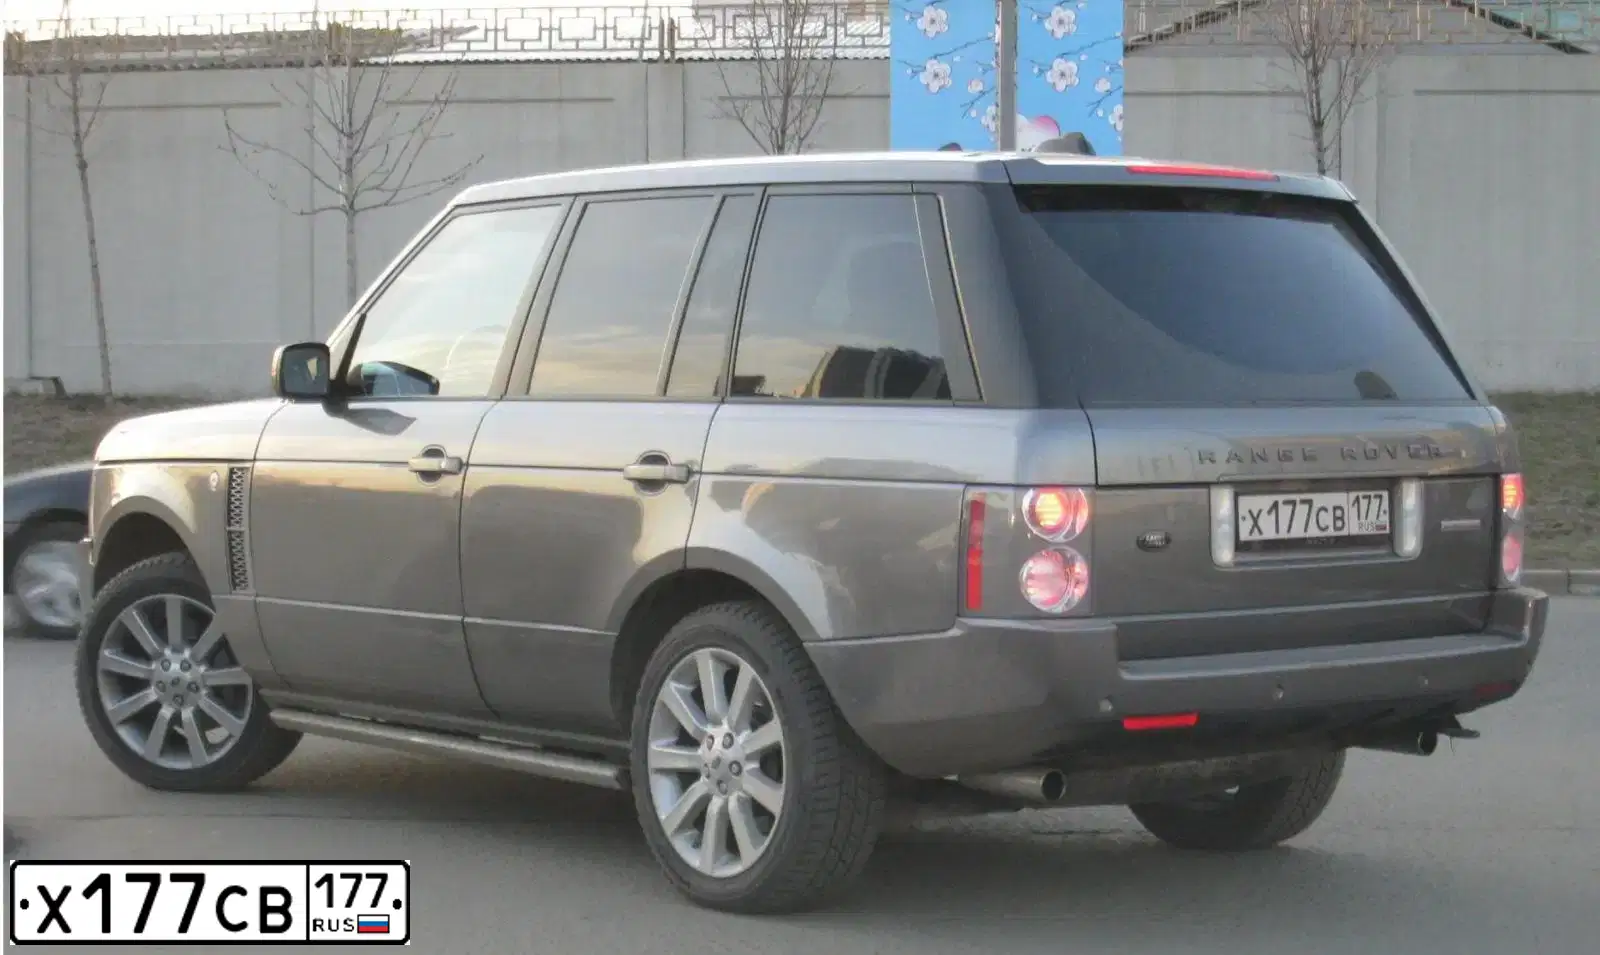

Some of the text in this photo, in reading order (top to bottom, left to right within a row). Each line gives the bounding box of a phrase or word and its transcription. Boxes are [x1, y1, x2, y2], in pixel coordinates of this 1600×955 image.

[1197, 442, 1443, 465] RANGE ROVER
[1351, 493, 1384, 521] 177
[1358, 521, 1376, 532] RUS
